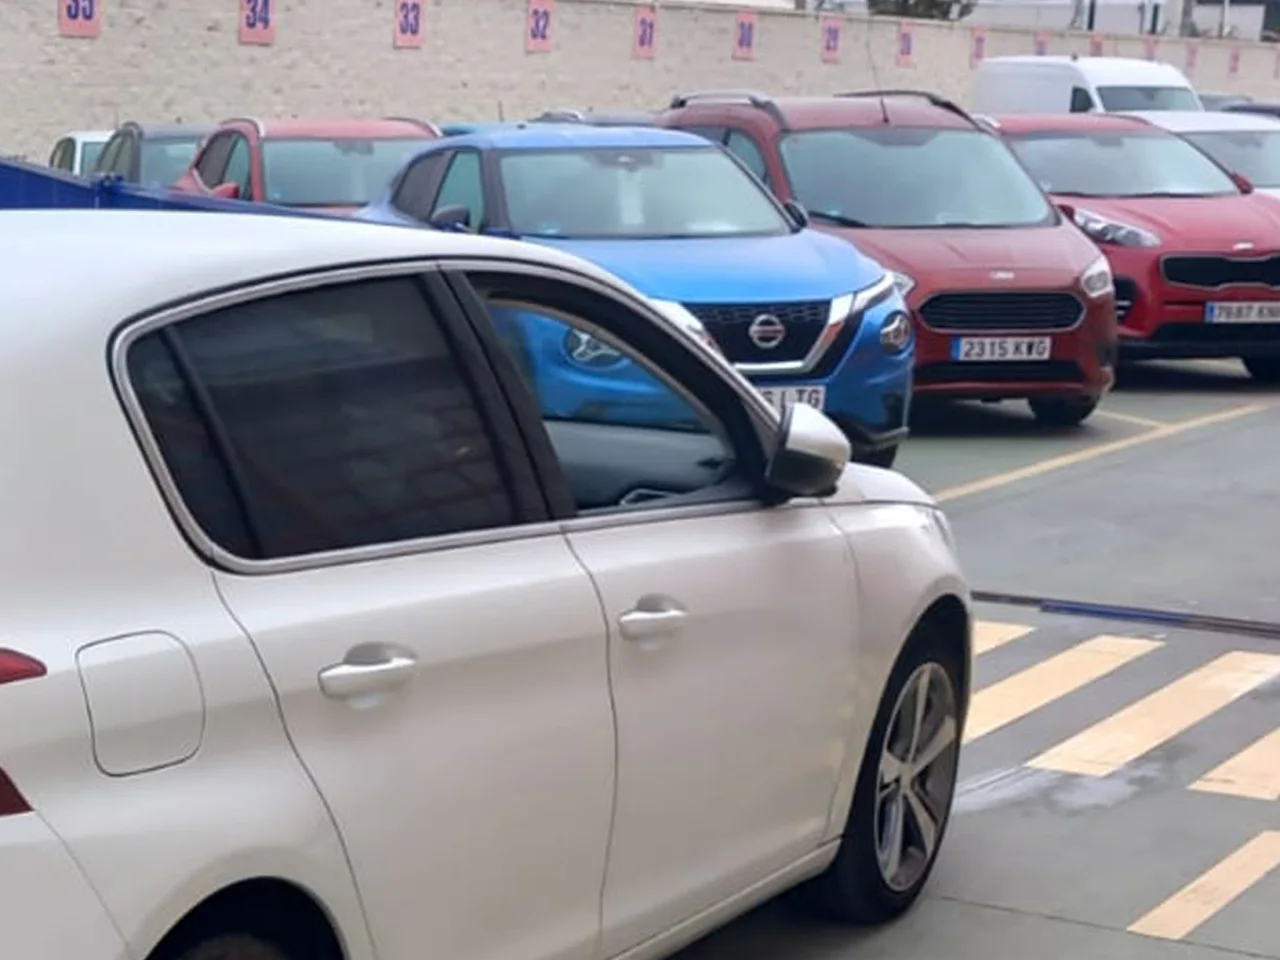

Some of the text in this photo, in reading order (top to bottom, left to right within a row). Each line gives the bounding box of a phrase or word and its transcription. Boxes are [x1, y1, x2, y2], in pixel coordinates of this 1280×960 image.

[245, 0, 270, 29] 34
[399, 2, 420, 35] 33
[530, 9, 549, 40] 32
[964, 341, 1008, 357] 2315
